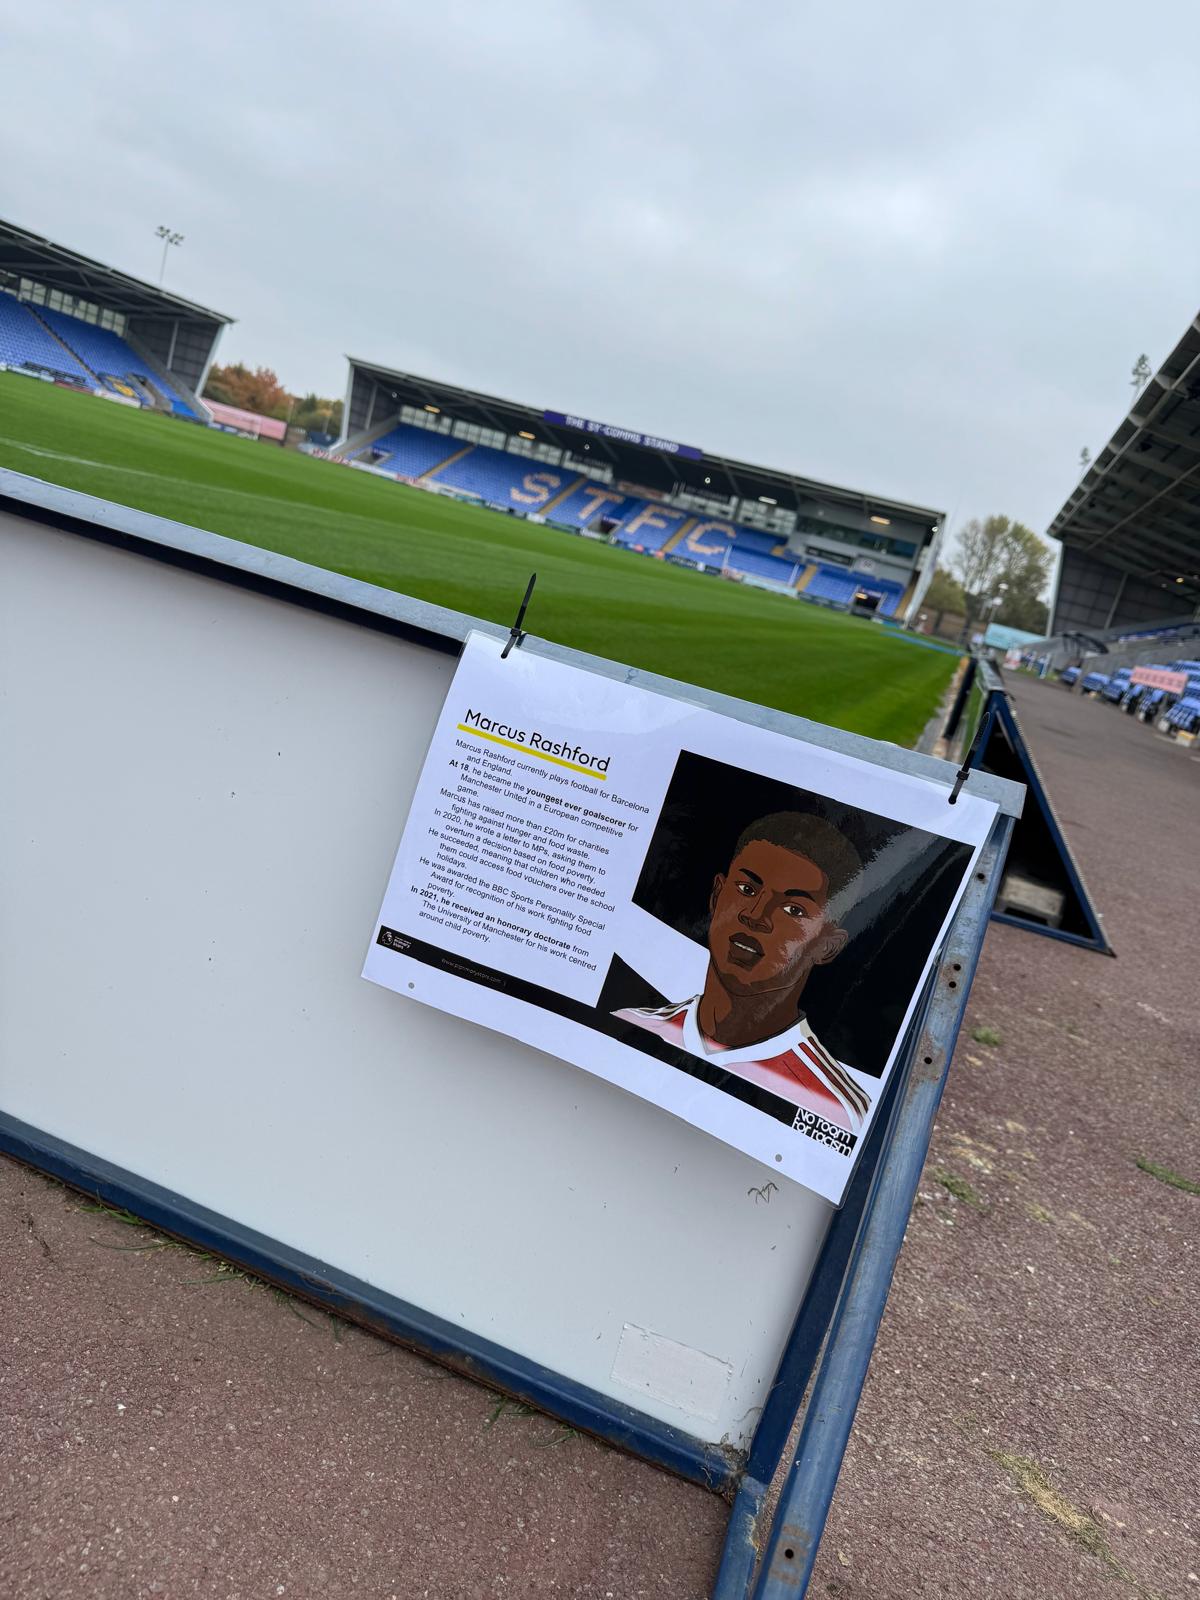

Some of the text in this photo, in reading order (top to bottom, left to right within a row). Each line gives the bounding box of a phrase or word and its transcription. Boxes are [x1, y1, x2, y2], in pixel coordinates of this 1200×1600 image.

[464, 708, 611, 772] Marcus Rashford
[466, 755, 512, 776] and England.
[448, 759, 639, 832] At 18, he became the youngest ever goalscorer for
[455, 738, 649, 814] Marcus Rashford currently plays football for Barcelona
[456, 784, 478, 797] game.
[460, 773, 502, 794] Manchester
[503, 788, 527, 803] United
[527, 797, 535, 806] in
[543, 803, 579, 822] European
[580, 818, 623, 837] competitive
[433, 807, 441, 816] In
[442, 811, 462, 825] 2020,
[463, 818, 473, 828] he
[475, 824, 494, 835] wrote
[502, 832, 521, 845] letter
[522, 840, 530, 848] to
[531, 843, 549, 856] MPs,
[551, 852, 576, 866] asking
[577, 860, 596, 872] them
[597, 867, 606, 875] to
[439, 787, 609, 855] Marcus has raised more than £20m for charities
[451, 803, 589, 859] fighting against hunger and food waste.
[427, 826, 605, 897] He succeeded, meaning that children who needed
[436, 851, 467, 870] holidays.
[439, 842, 615, 912] them could access food vouchers over the school
[445, 824, 474, 839] overturn
[482, 837, 511, 853] decision
[512, 847, 536, 861] based
[548, 860, 565, 872] food
[565, 868, 595, 884] poverty.
[410, 884, 589, 957] In 2021, he received an honorary doctorate from
[419, 856, 605, 930] He was awarded the BBC Sports Personality Special
[426, 882, 454, 897] poverty.
[430, 871, 453, 885] Award
[454, 880, 464, 889] for
[465, 886, 504, 904] recognition
[514, 902, 526, 912] his
[527, 908, 545, 919] work
[546, 914, 573, 931] fighting
[574, 924, 592, 936] food
[418, 910, 490, 943] around child poverty.
[423, 899, 435, 910] The
[437, 905, 472, 925] University
[481, 922, 524, 943] Manchester
[525, 938, 536, 947] for
[536, 942, 548, 952] his
[549, 948, 567, 959] work
[568, 955, 597, 971] centred
[795, 1107, 852, 1144] No room
[810, 1128, 852, 1158] racism
